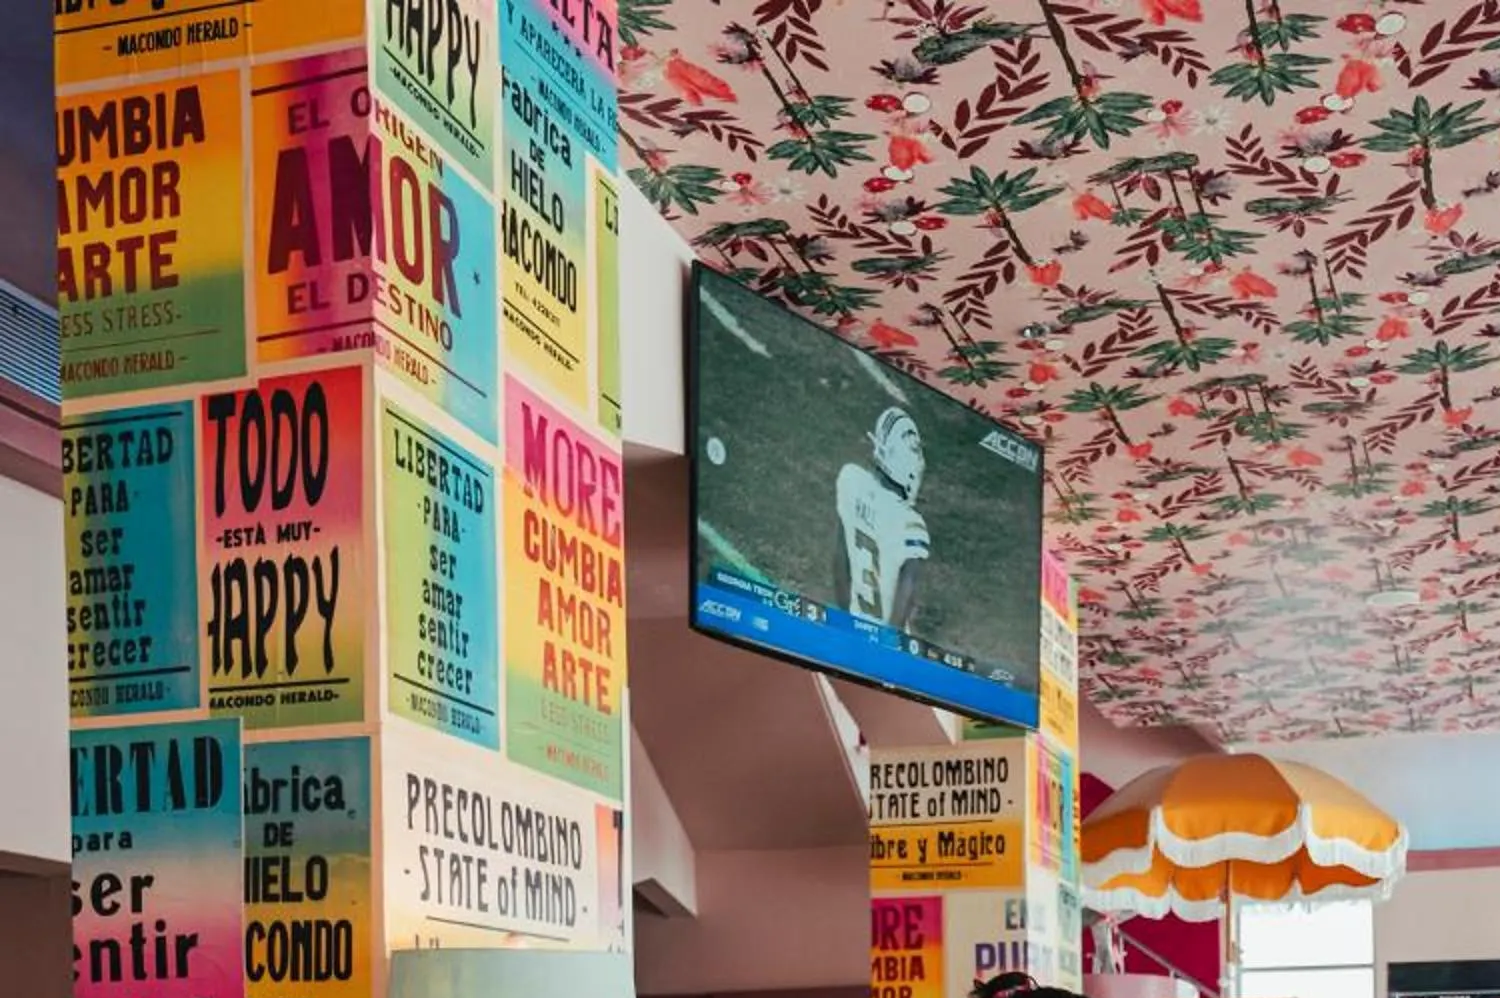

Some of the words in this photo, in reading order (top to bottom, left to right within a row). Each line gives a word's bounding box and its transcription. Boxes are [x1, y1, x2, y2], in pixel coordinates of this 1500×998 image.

[117, 27, 182, 57] MACONDO
[186, 17, 239, 45] HERALD
[287, 101, 330, 136] EL
[529, 138, 545, 172] DE
[511, 149, 564, 235] HIELO
[268, 132, 461, 320] AMOR
[57, 229, 179, 303] ARTE
[287, 281, 330, 316] EL
[347, 271, 453, 353] DESTINO
[123, 350, 175, 376] HERALD
[208, 380, 329, 519] TODO
[394, 428, 485, 514] LIBERTAD
[521, 401, 621, 550] MORE
[71, 479, 130, 518] PARA
[423, 495, 461, 544] PARA
[80, 527, 124, 558] ser
[429, 543, 458, 580] ser
[523, 507, 623, 609] CUMBIA
[69, 563, 135, 596] amar
[422, 577, 464, 620] amar
[67, 591, 146, 635] sentir
[537, 576, 613, 660] AMOR
[418, 613, 470, 659] sentir
[417, 650, 473, 695] crecer
[542, 639, 613, 717] ARTE
[406, 773, 583, 871] PRECOLOMBINO
[927, 791, 946, 817] of
[951, 787, 1001, 816] MIND
[71, 831, 133, 858] para
[263, 821, 294, 848] DE
[917, 836, 928, 864] y
[418, 844, 489, 913] STATE
[497, 865, 517, 919] of
[524, 866, 577, 928] MIND
[245, 920, 352, 983] CONDO
